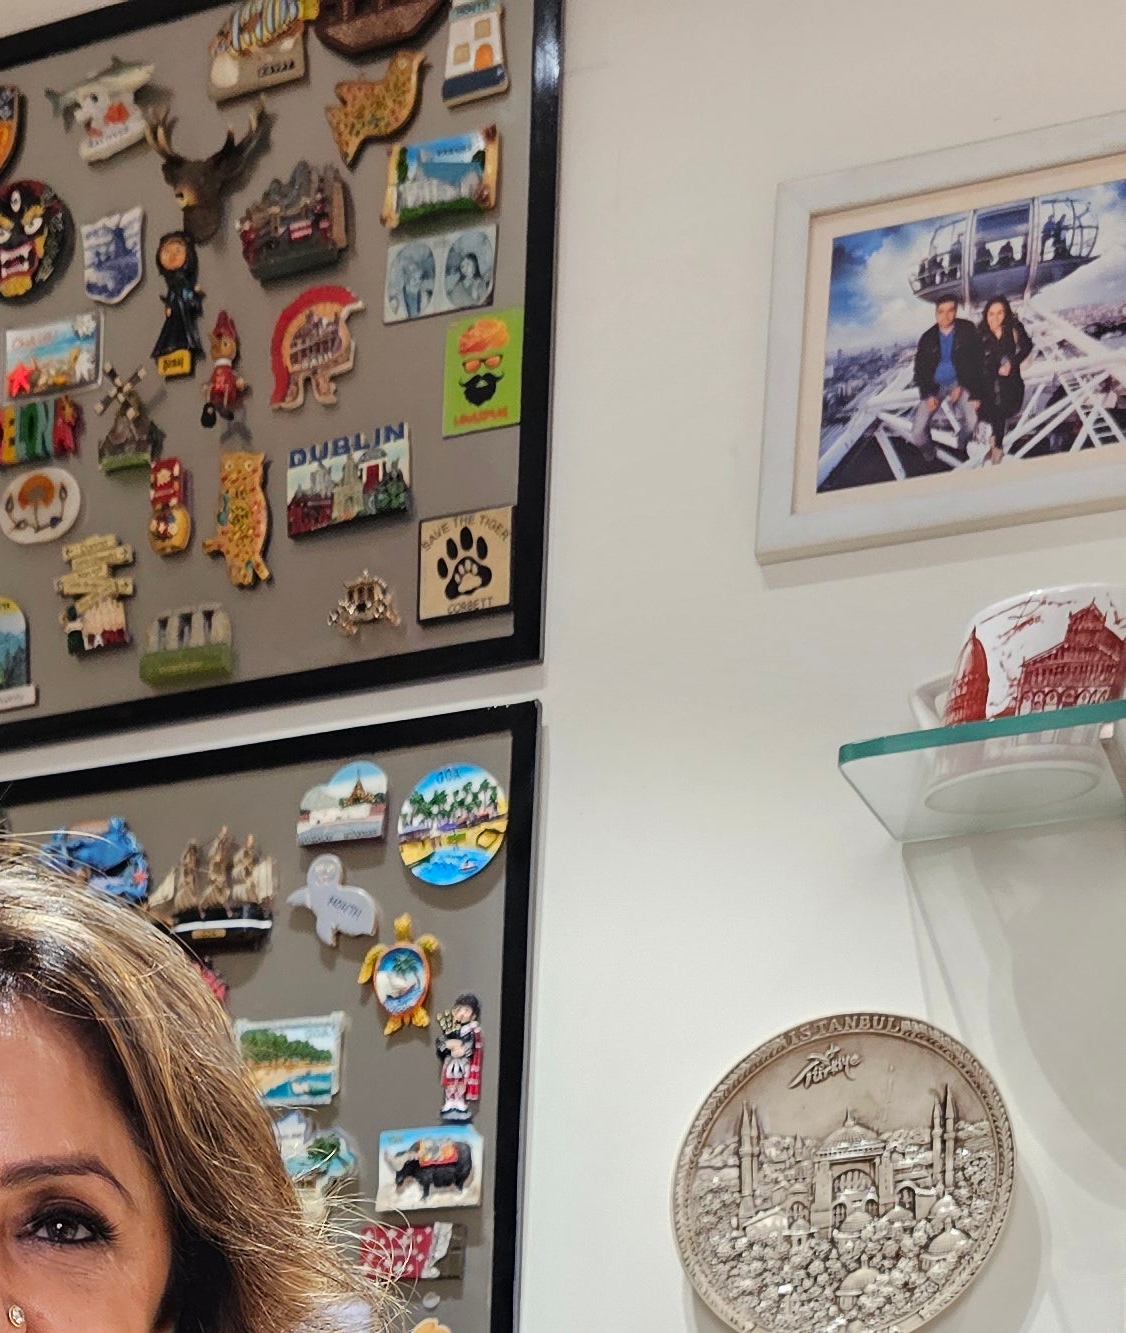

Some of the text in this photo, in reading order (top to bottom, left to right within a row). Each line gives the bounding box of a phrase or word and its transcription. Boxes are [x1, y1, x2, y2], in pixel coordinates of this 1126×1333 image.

[289, 421, 405, 468] DUBLIN
[422, 515, 509, 552] SAVE THE TIGER
[447, 597, 494, 614] CORBETT
[788, 1014, 900, 1045] ISTANBUL
